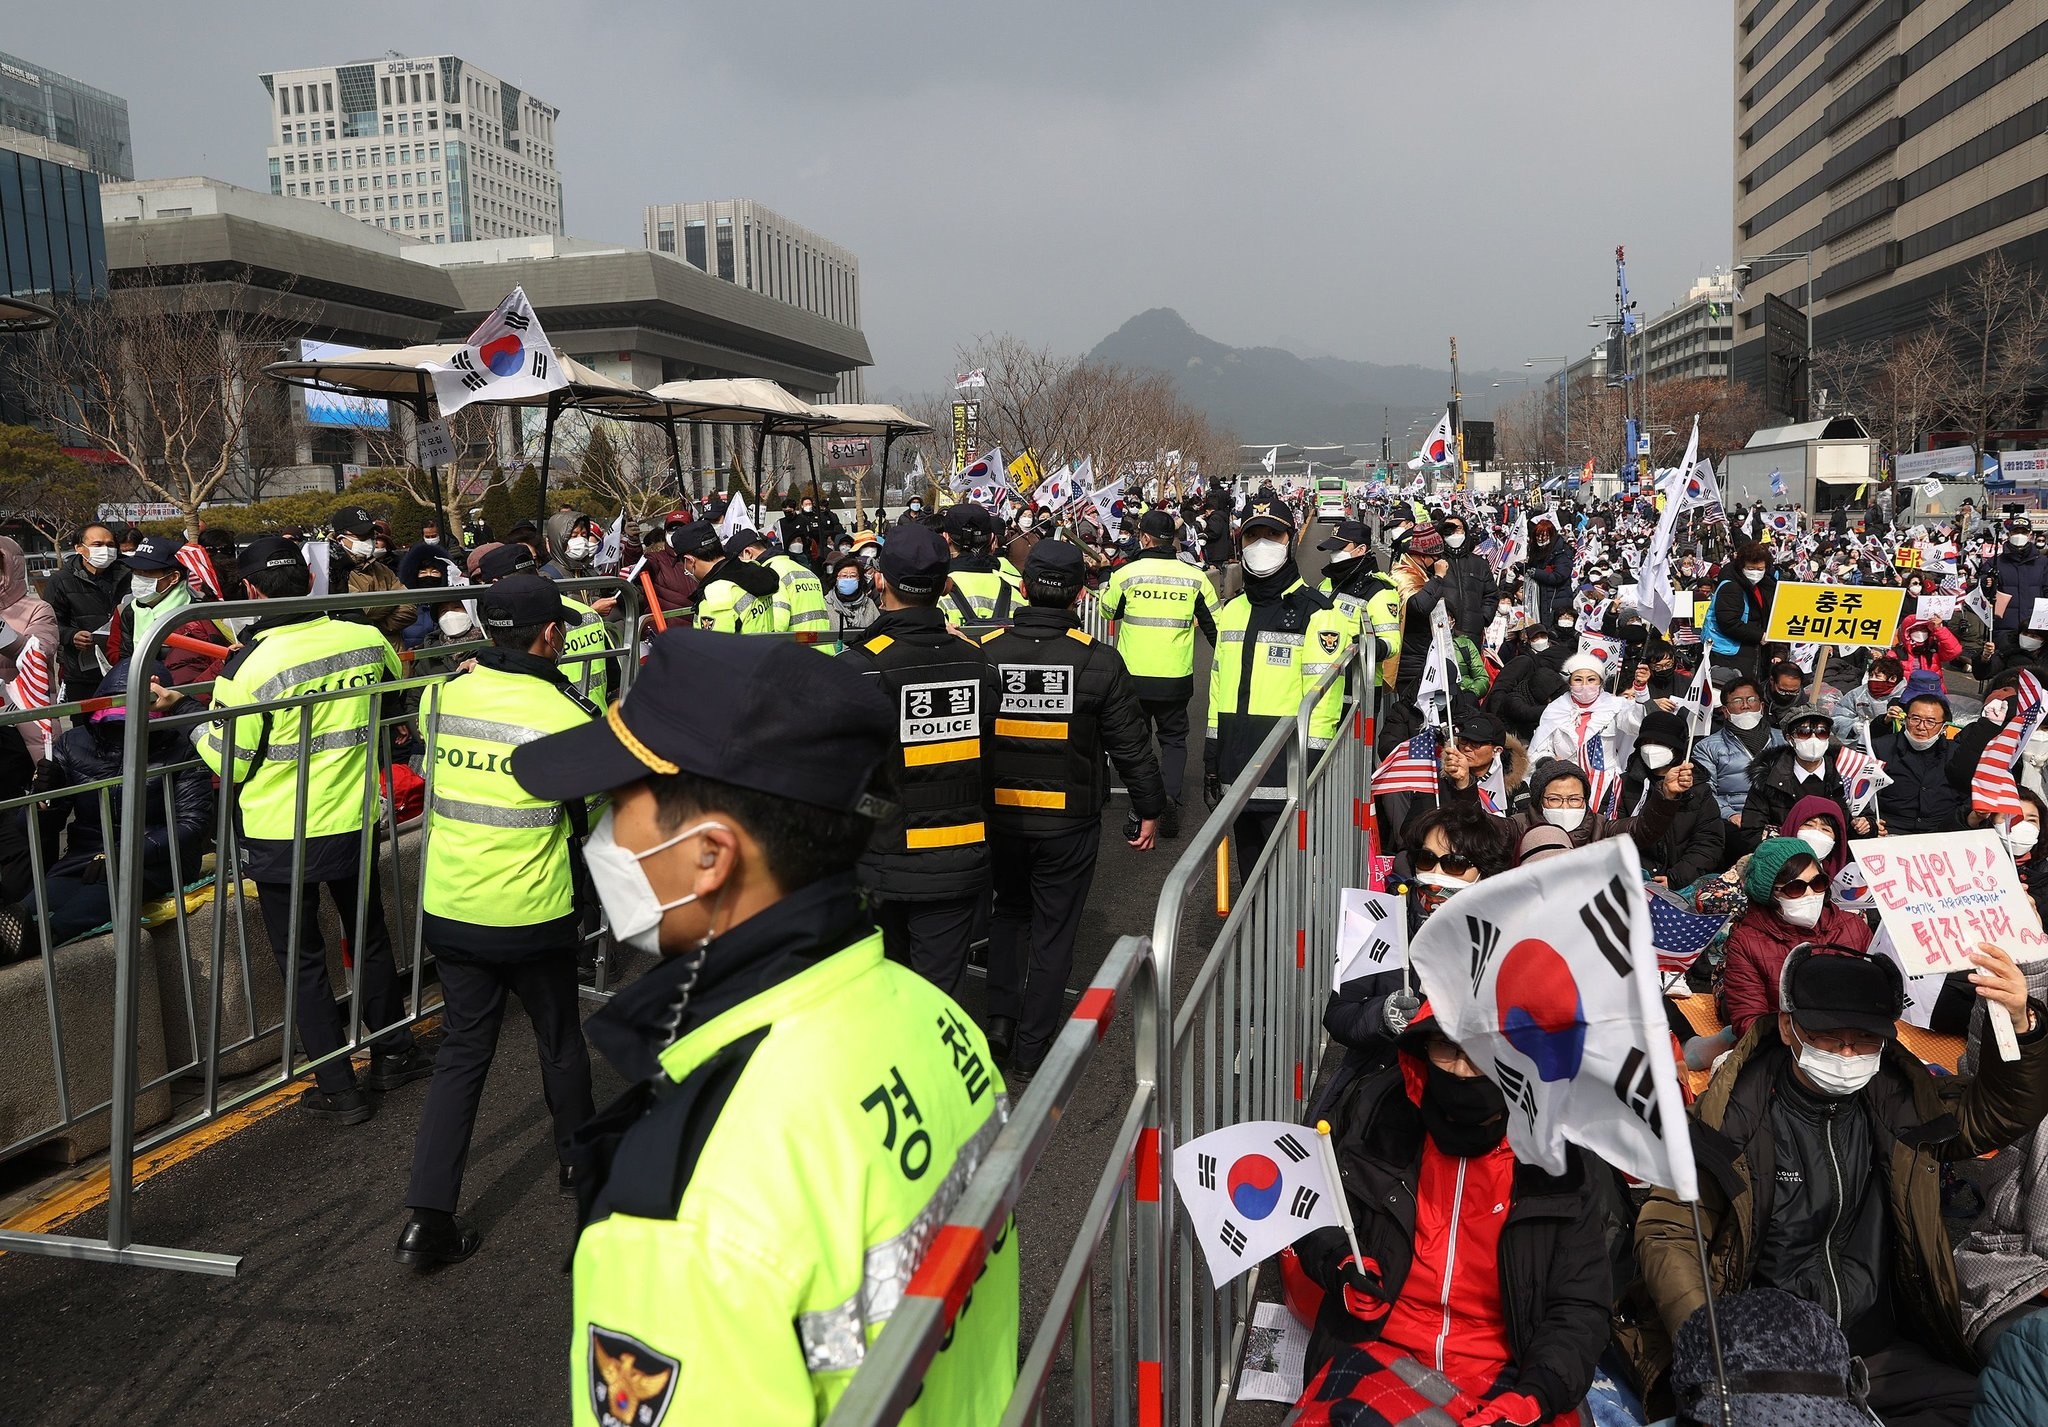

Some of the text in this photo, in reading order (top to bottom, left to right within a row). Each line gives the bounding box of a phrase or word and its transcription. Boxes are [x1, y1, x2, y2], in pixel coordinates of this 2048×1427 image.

[387, 62, 434, 74] 외교부 MOFA
[831, 443, 869, 459] 용산구
[1039, 577, 1062, 586] POLICE
[751, 594, 774, 619] POLIC
[1133, 590, 1188, 601] POLICE
[1815, 591, 1863, 614] 충주
[1786, 615, 1882, 640] 살미지역
[563, 629, 604, 654] POLICE
[283, 671, 377, 713] OLICE
[1006, 670, 1065, 694] 경찰
[909, 687, 972, 718] 경찰
[1005, 698, 1065, 709] POLICE
[909, 719, 972, 736] POLICE
[435, 746, 514, 775] POLIC
[860, 1007, 991, 1181] 경찰
